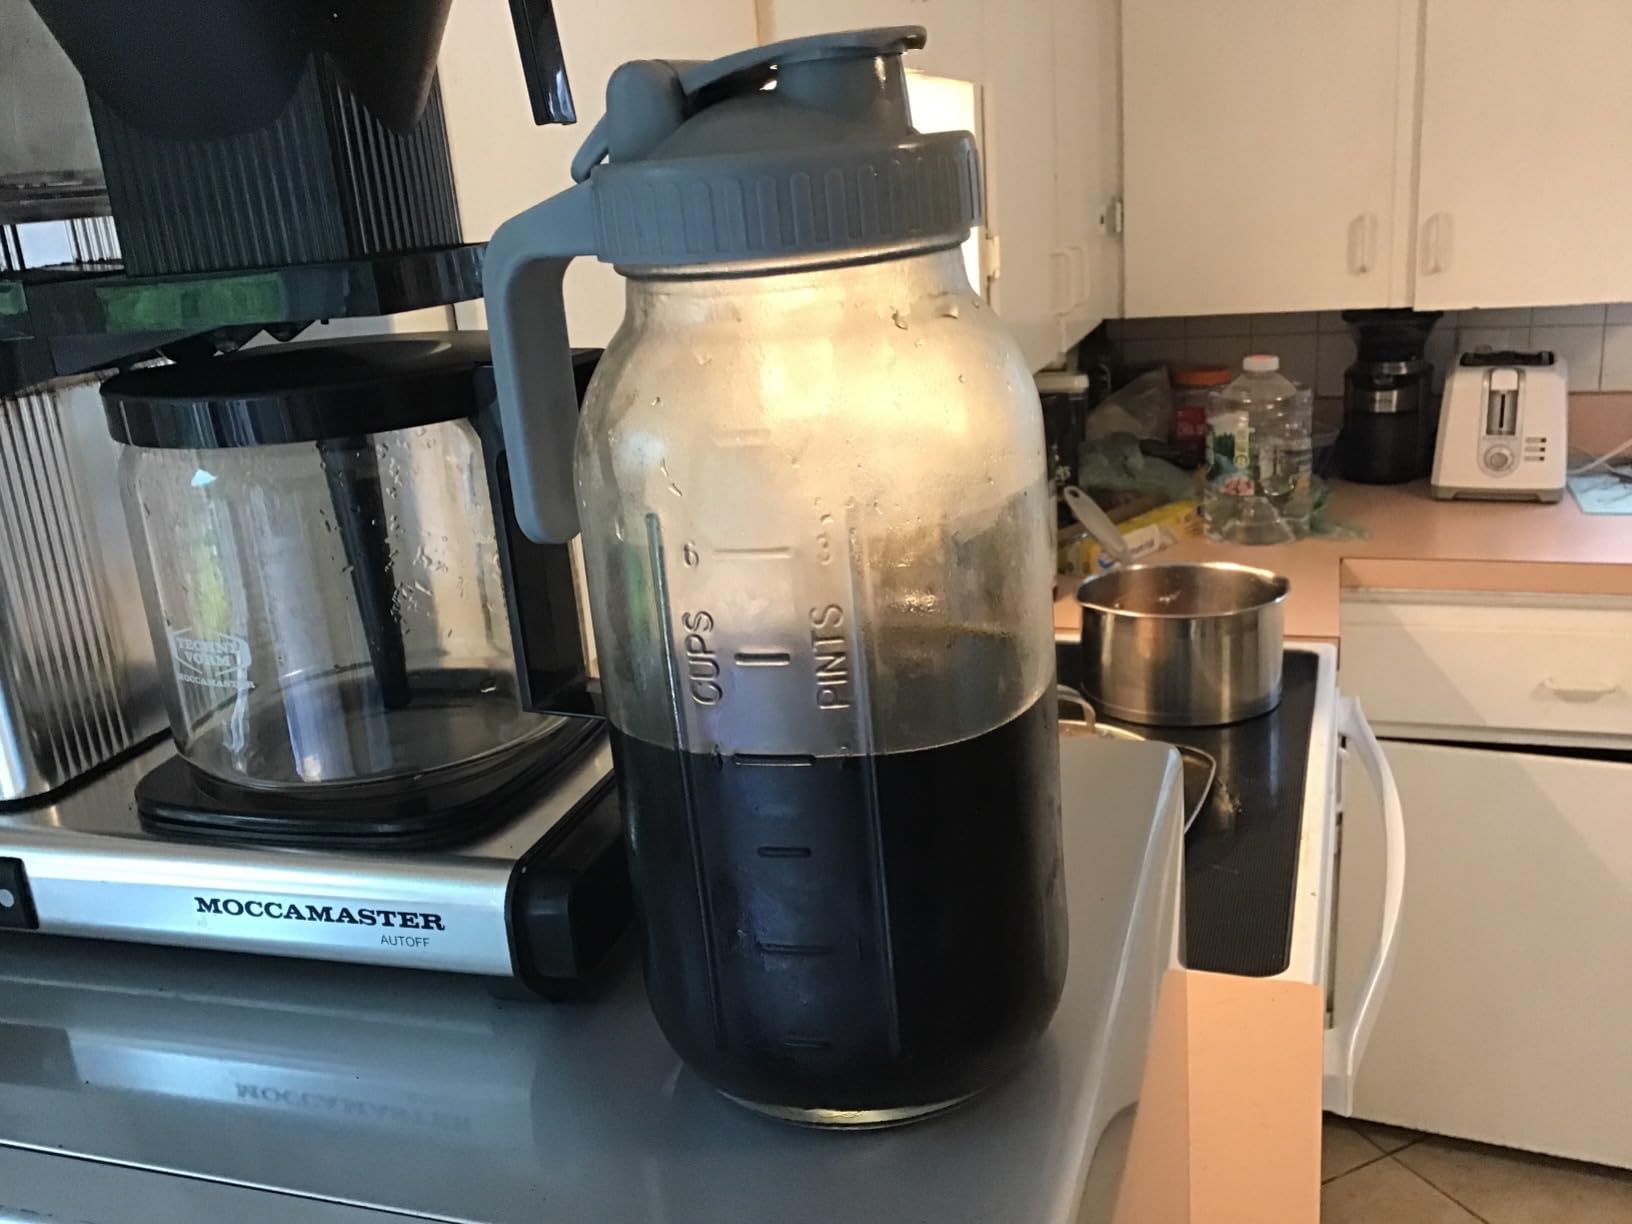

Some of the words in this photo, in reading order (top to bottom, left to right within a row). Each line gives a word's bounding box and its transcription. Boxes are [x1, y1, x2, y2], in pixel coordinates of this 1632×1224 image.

[682, 540, 700, 569] 6
[682, 610, 724, 706] CUPS
[809, 603, 850, 710] PINTS
[194, 896, 446, 931] MOCCAMASTER
[380, 934, 430, 947] AUTOFF
